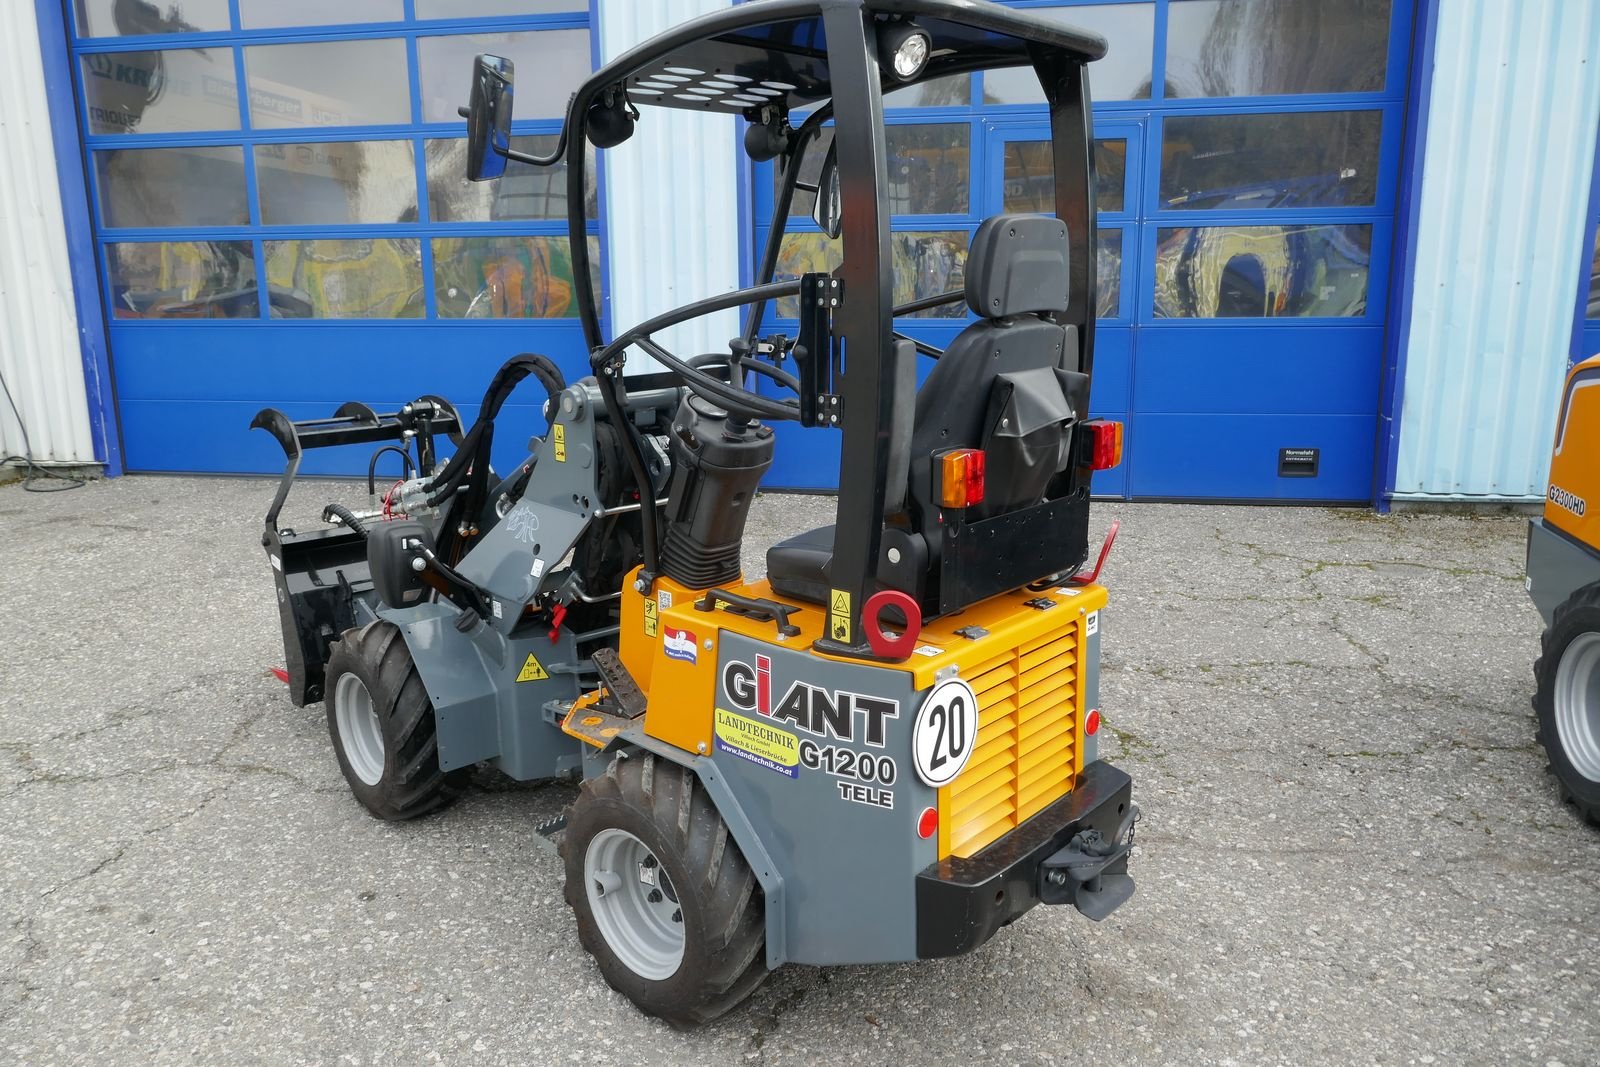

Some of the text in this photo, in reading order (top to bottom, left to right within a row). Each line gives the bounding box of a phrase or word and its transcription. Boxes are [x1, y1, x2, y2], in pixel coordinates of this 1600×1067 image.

[1549, 484, 1585, 517] G2300HD
[718, 712, 795, 750] LANDTECHNIK
[725, 734, 745, 746] Villach
[929, 696, 965, 771] 20
[721, 744, 792, 776] www.landtechnik.co.at
[798, 739, 897, 785] G1200
[837, 780, 894, 809] TELE
